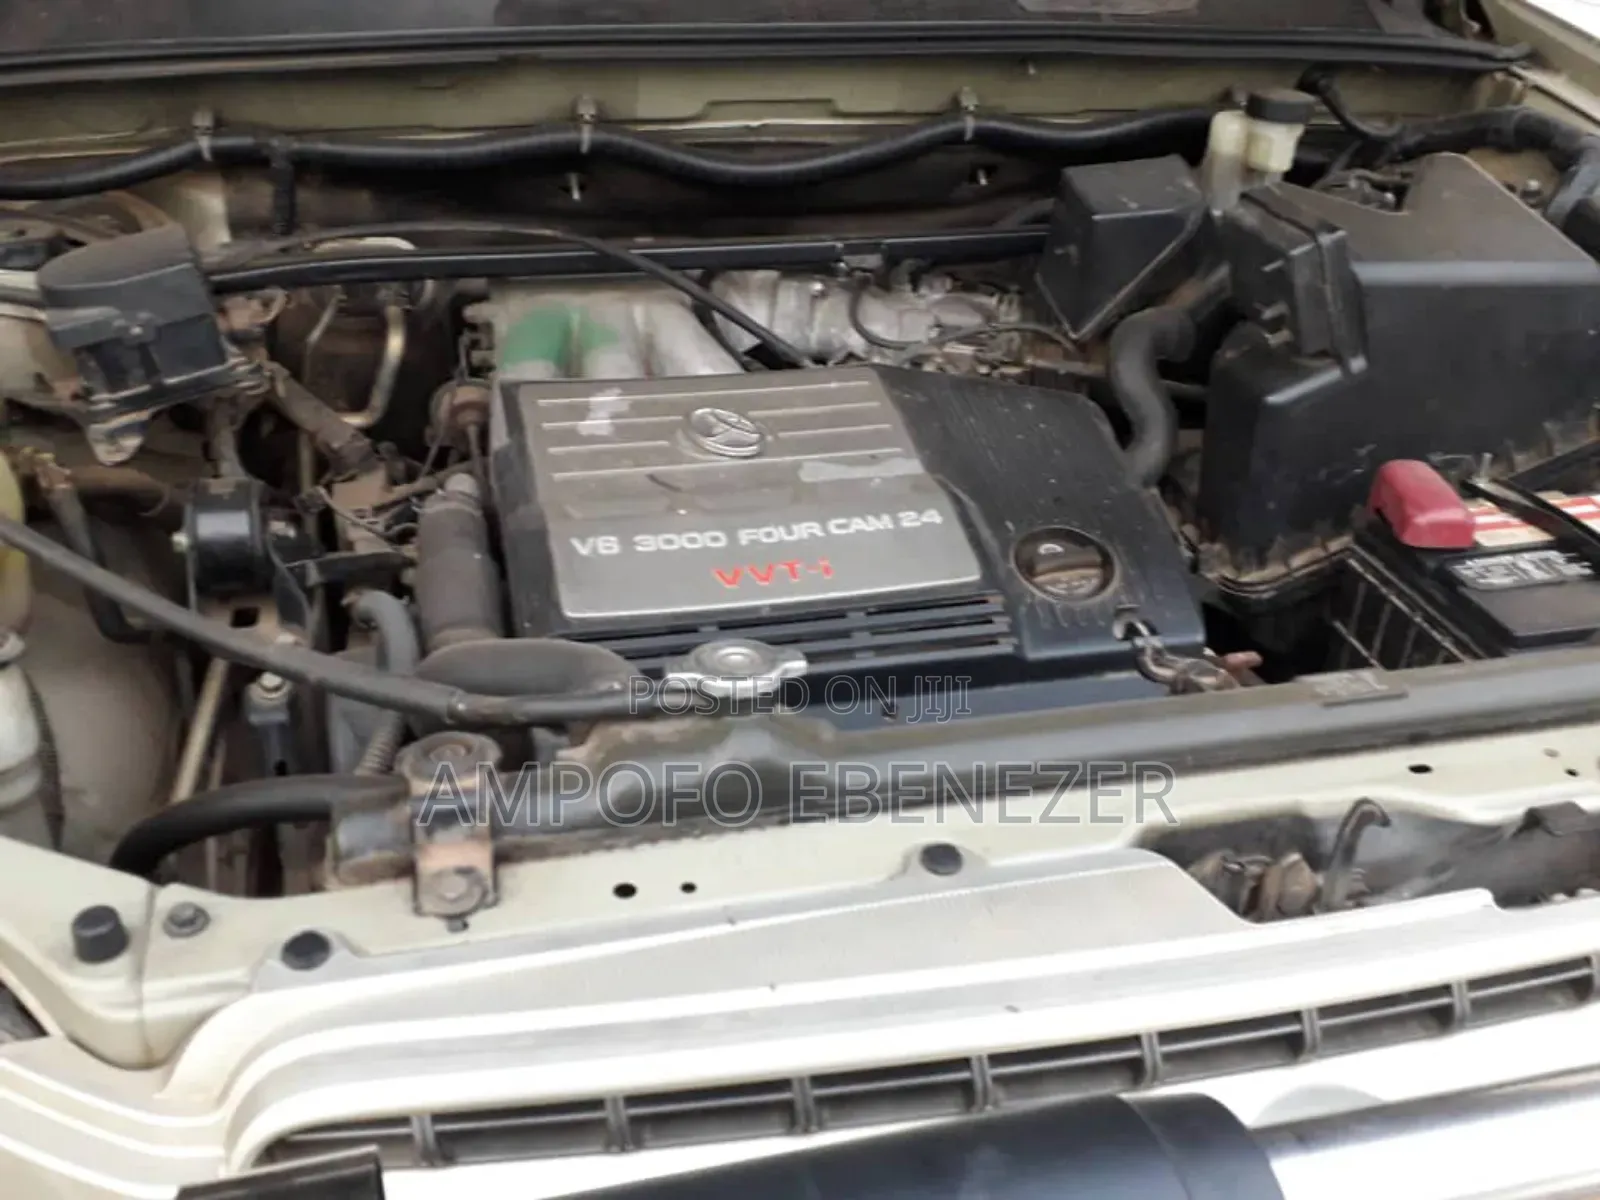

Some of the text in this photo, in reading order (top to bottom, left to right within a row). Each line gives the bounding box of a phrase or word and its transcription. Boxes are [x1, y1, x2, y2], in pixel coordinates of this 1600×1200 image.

[632, 530, 727, 552] 3000
[737, 521, 825, 546] FOUR
[826, 513, 894, 535] CAM
[898, 508, 943, 528] 24
